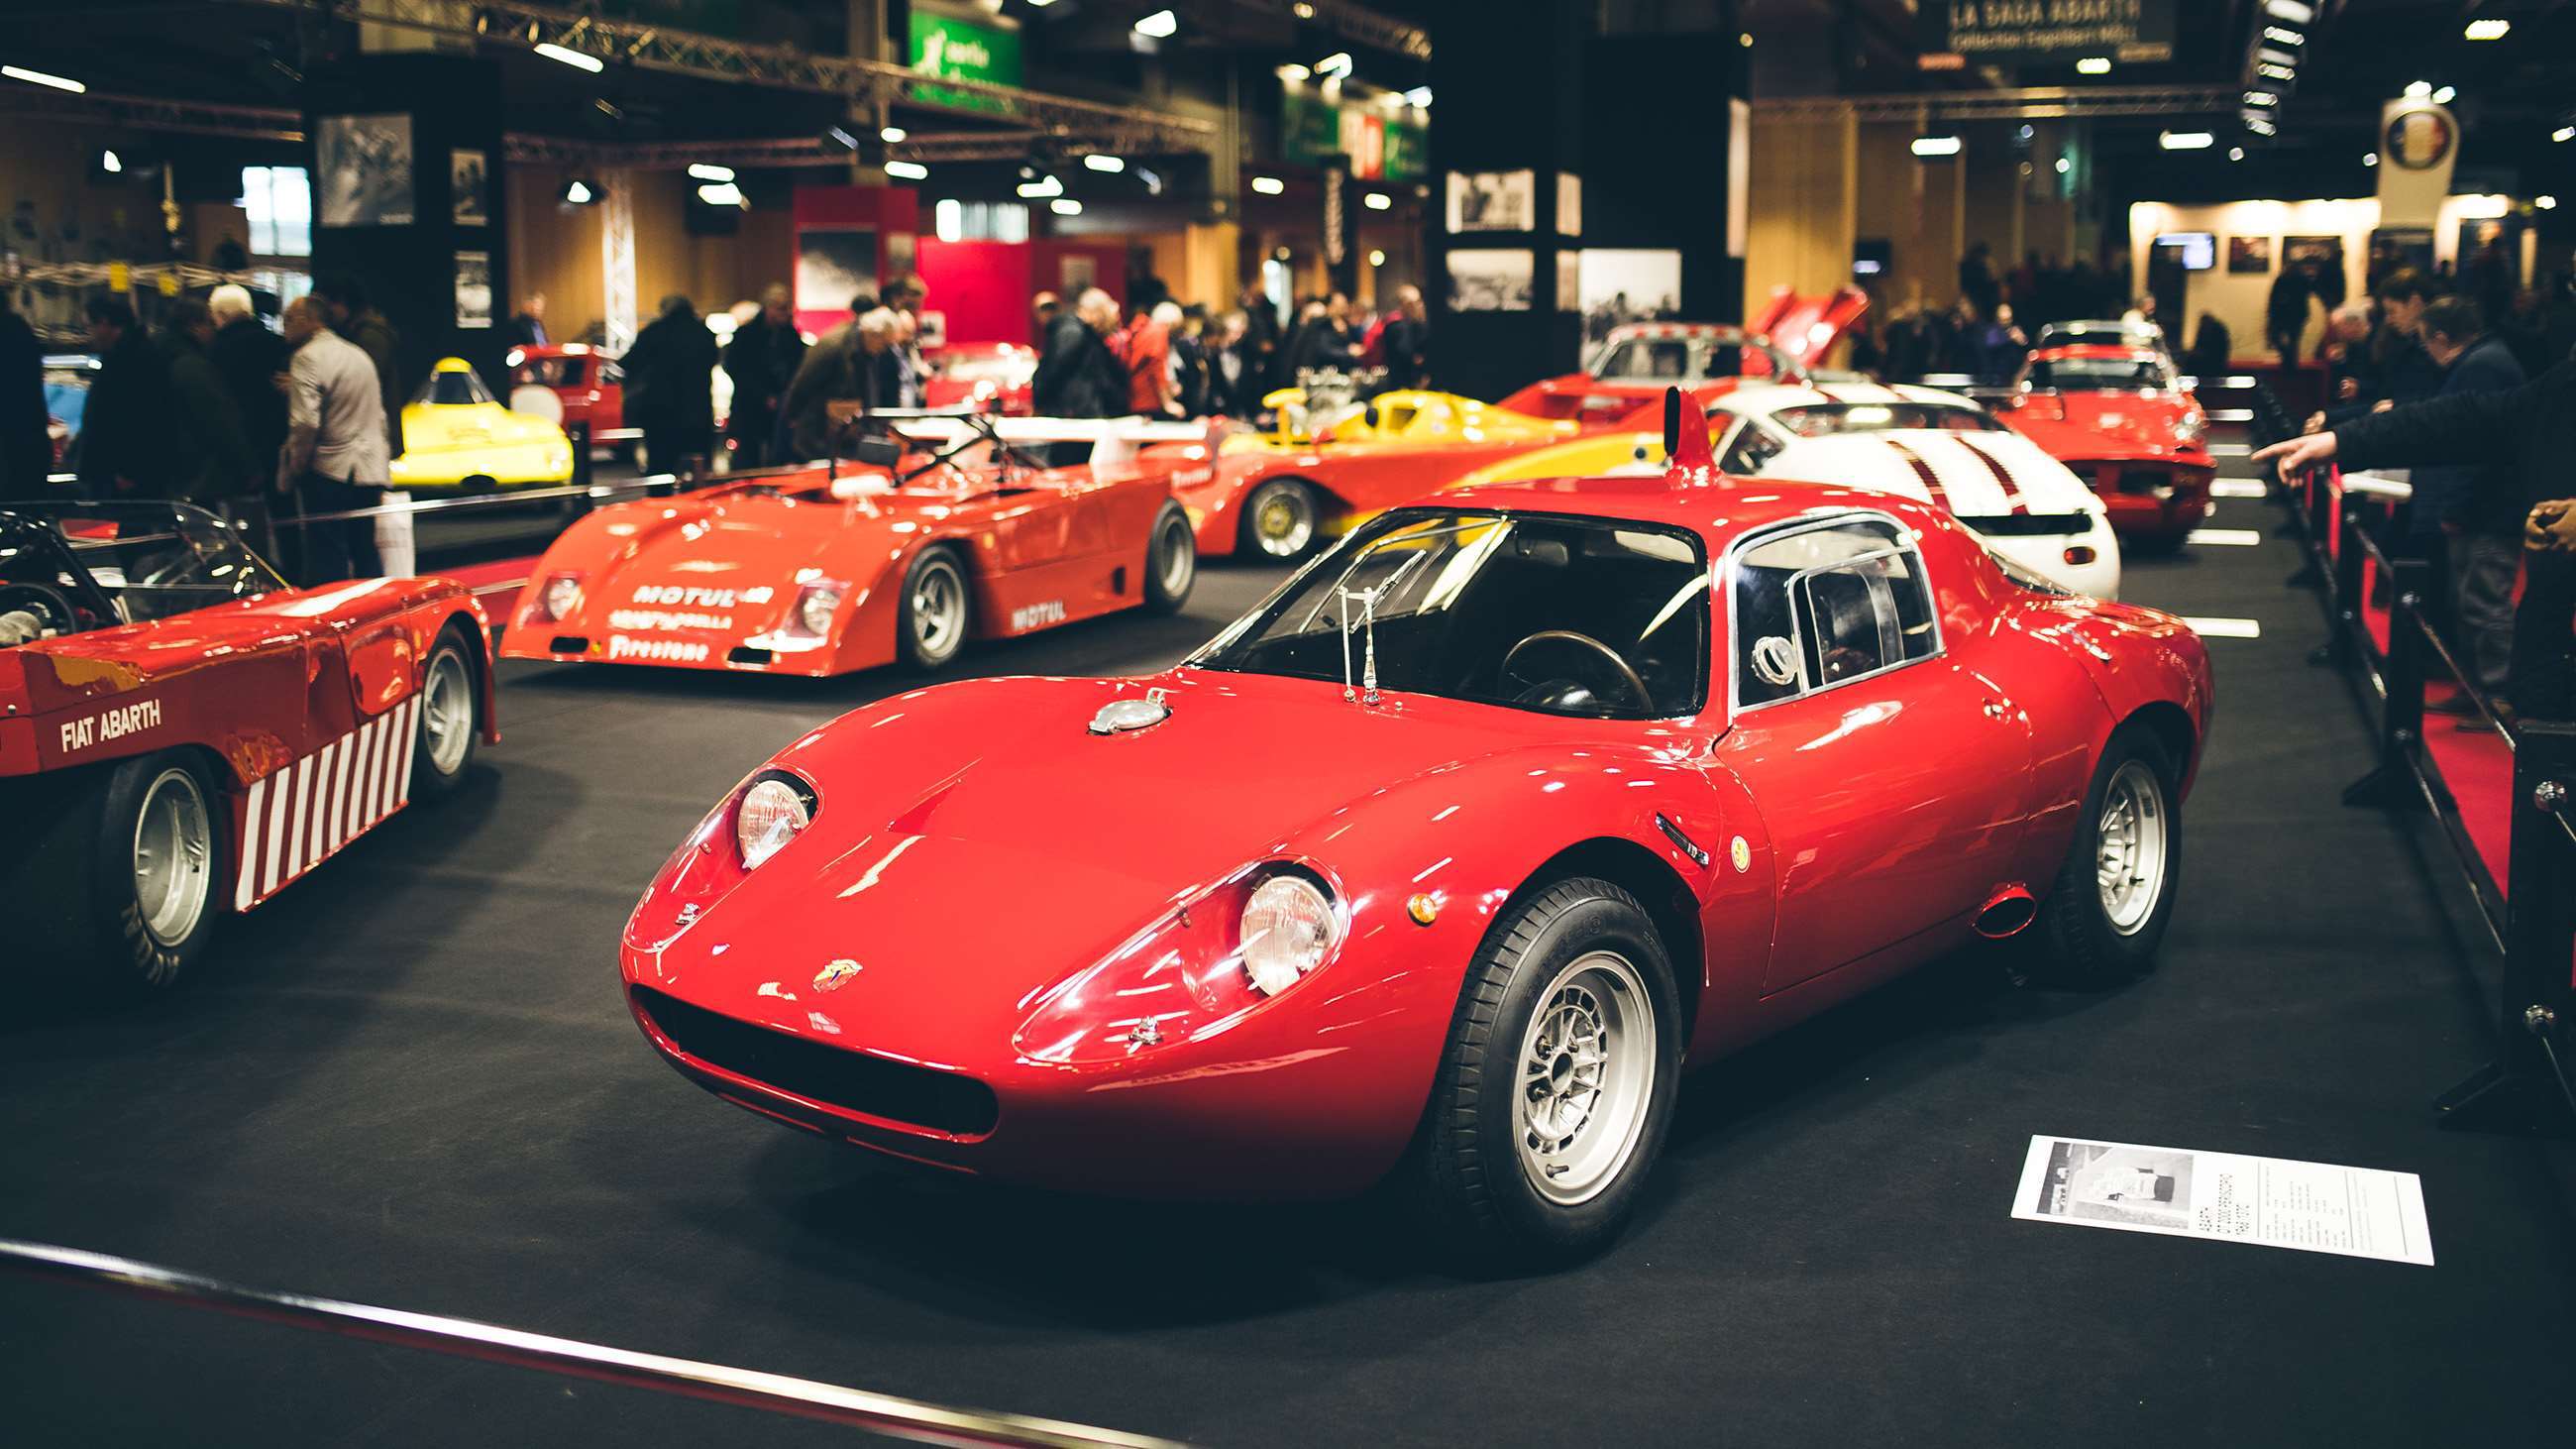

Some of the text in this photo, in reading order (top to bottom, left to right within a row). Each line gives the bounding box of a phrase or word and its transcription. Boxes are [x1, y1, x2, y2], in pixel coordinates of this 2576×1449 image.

[1950, 0, 2141, 29] LA SAGA ABARTH
[632, 585, 736, 608] MOTUL
[1012, 600, 1067, 630] MOTUL
[608, 634, 709, 662] Firestone
[60, 699, 161, 753] FIAT ABARTH
